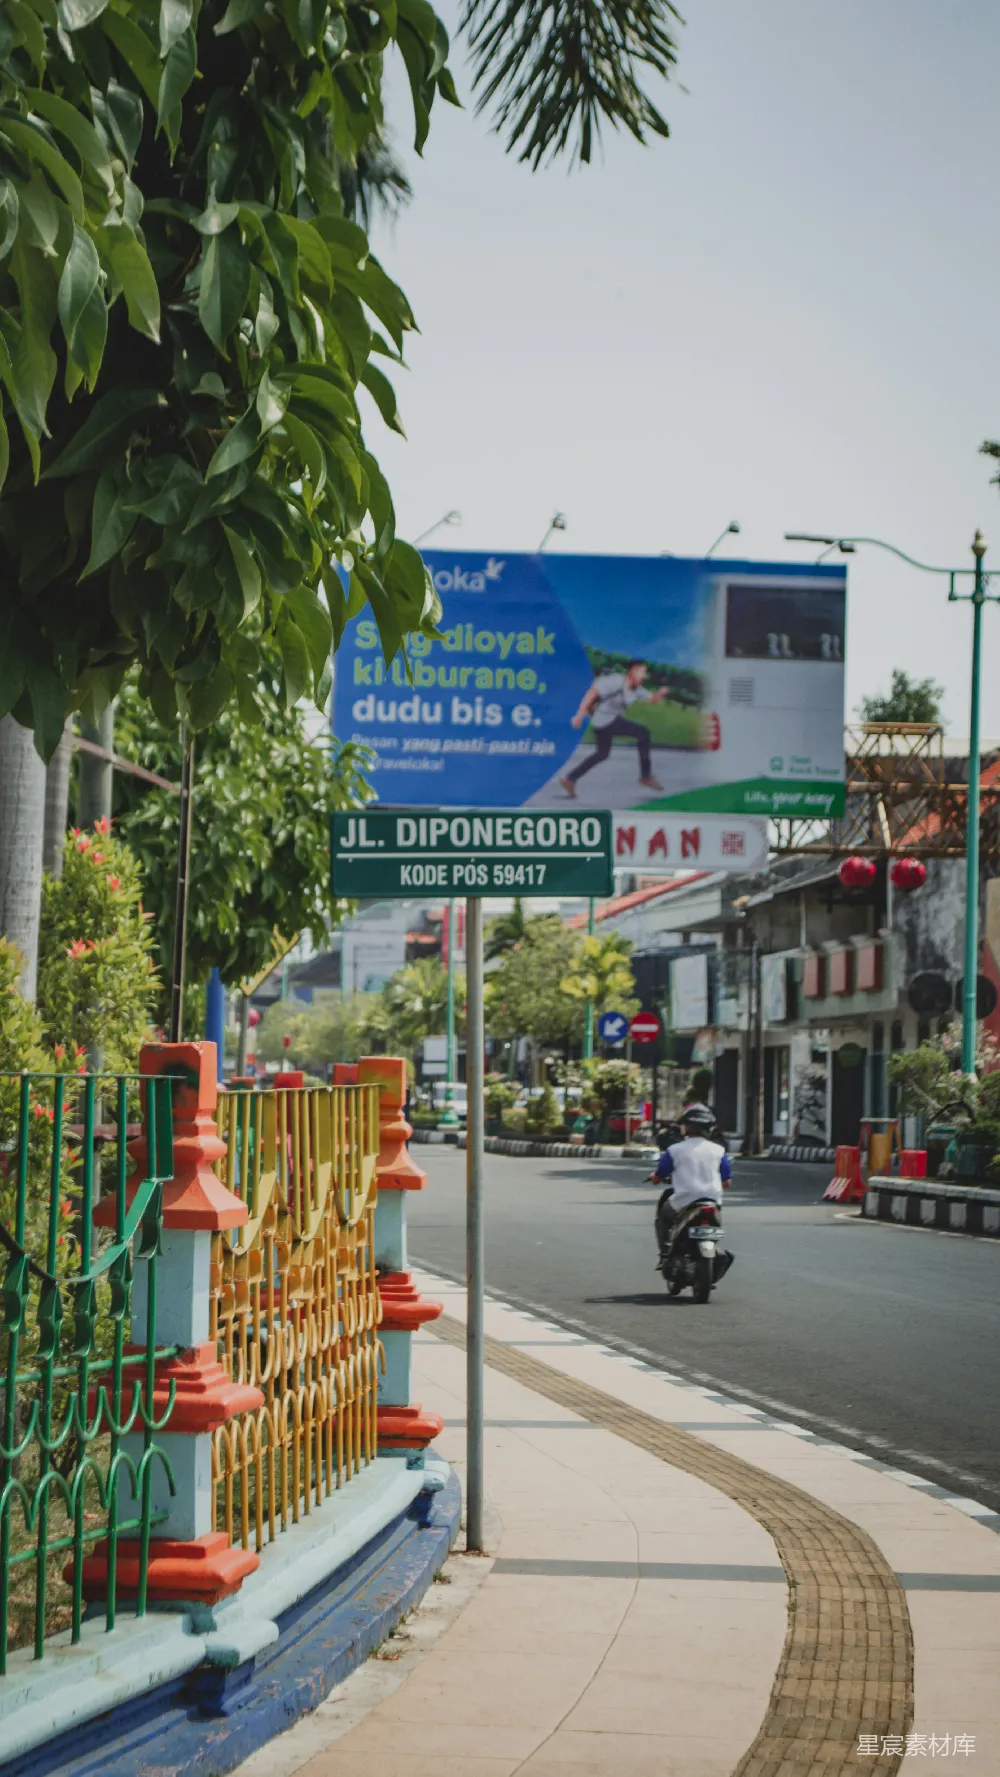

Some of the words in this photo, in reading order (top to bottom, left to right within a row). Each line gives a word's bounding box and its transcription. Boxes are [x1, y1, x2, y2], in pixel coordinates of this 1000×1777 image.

[355, 620, 433, 657] Sg
[441, 623, 555, 660] dioyak
[353, 656, 383, 686] ki
[352, 694, 442, 724] dudu
[451, 696, 502, 727] bis
[511, 703, 542, 727] e.
[340, 817, 385, 848] JL.
[396, 816, 601, 848] DIPONEGORO
[400, 864, 448, 886] KODE
[452, 864, 488, 886] POS
[493, 864, 547, 886] 59417
